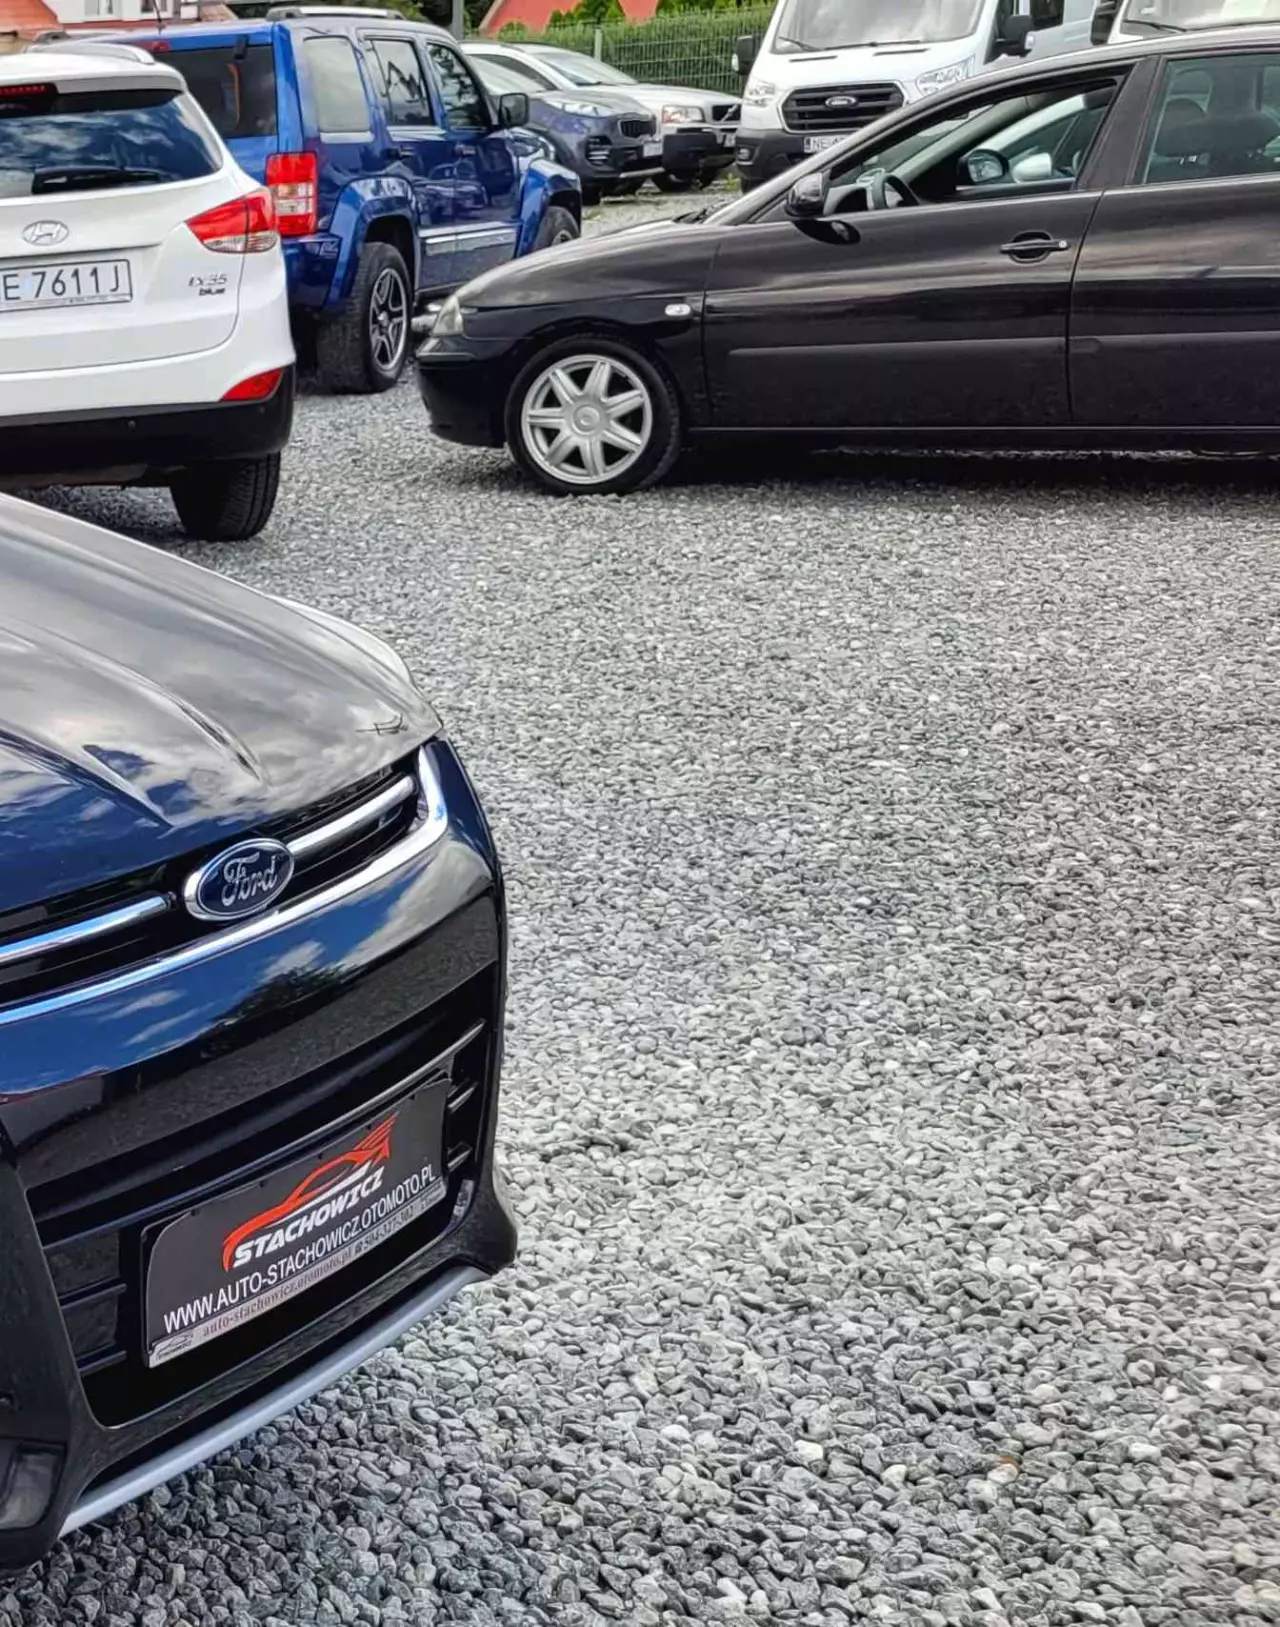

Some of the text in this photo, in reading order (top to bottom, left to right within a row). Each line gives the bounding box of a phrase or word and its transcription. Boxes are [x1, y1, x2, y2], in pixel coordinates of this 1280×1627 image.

[32, 264, 120, 298] 7611J
[221, 851, 278, 907] Ford
[163, 1163, 436, 1334] WWW.AUTO-STACHOWICZ.OTOMOTO.PL
[232, 1165, 385, 1267] STACHOWICZ
